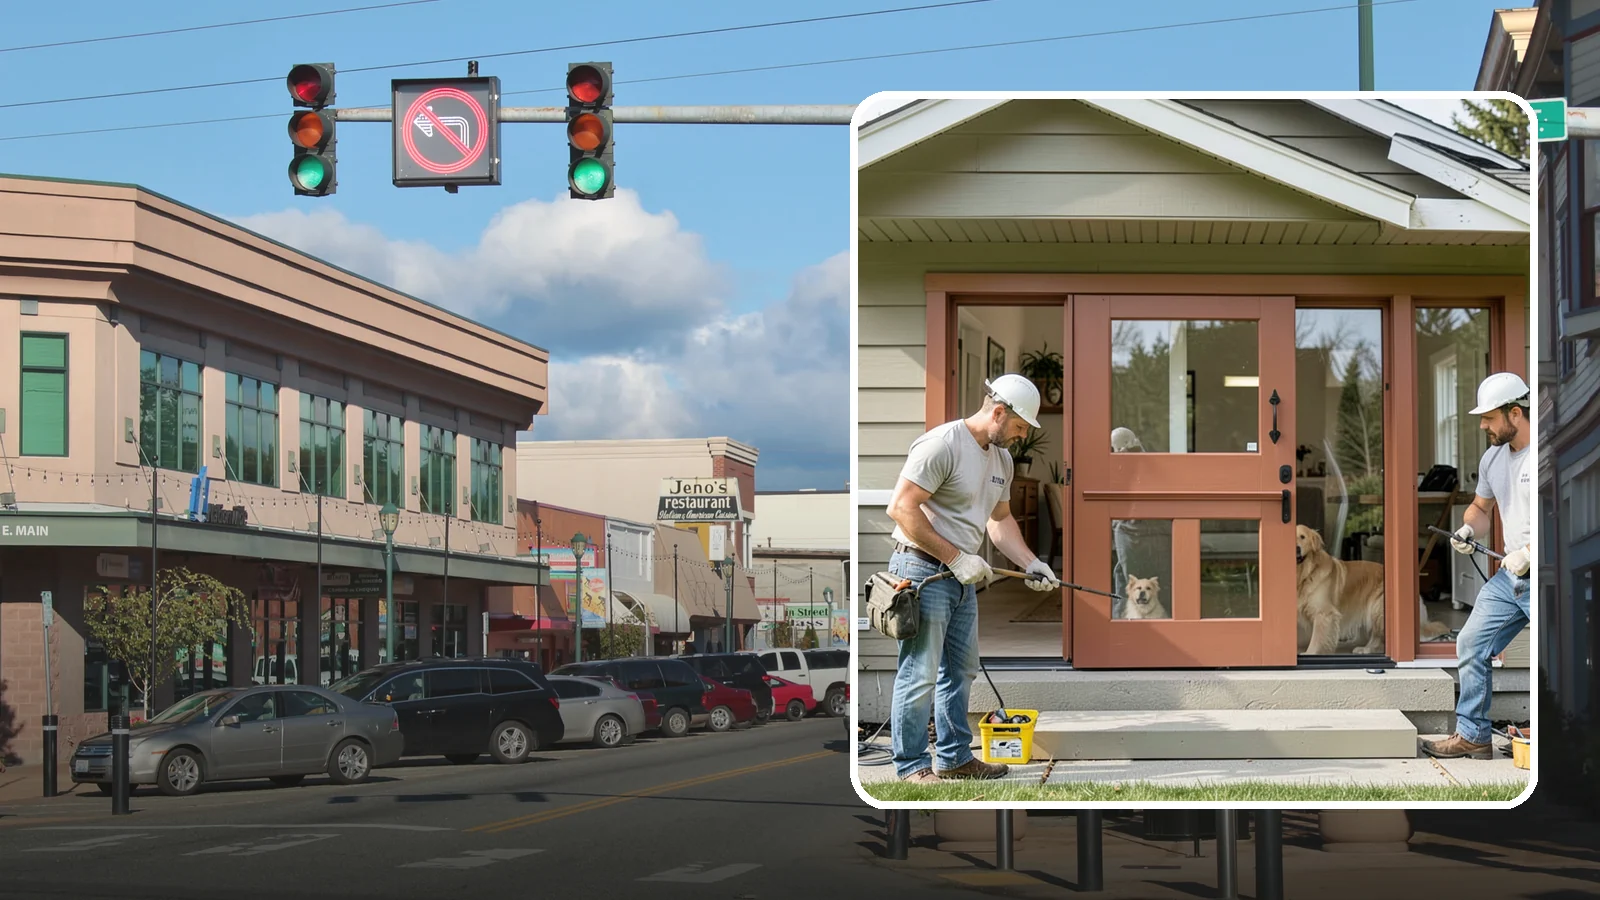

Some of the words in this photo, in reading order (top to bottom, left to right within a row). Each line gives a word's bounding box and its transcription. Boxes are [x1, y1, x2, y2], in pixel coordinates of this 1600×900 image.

[669, 479, 728, 495] Jeno's
[665, 496, 731, 509] restaurant
[686, 510, 714, 519] American
[715, 509, 737, 519] Cuisine
[2, 525, 13, 536] E.
[15, 525, 49, 536] MAIN
[797, 608, 828, 617] Street
